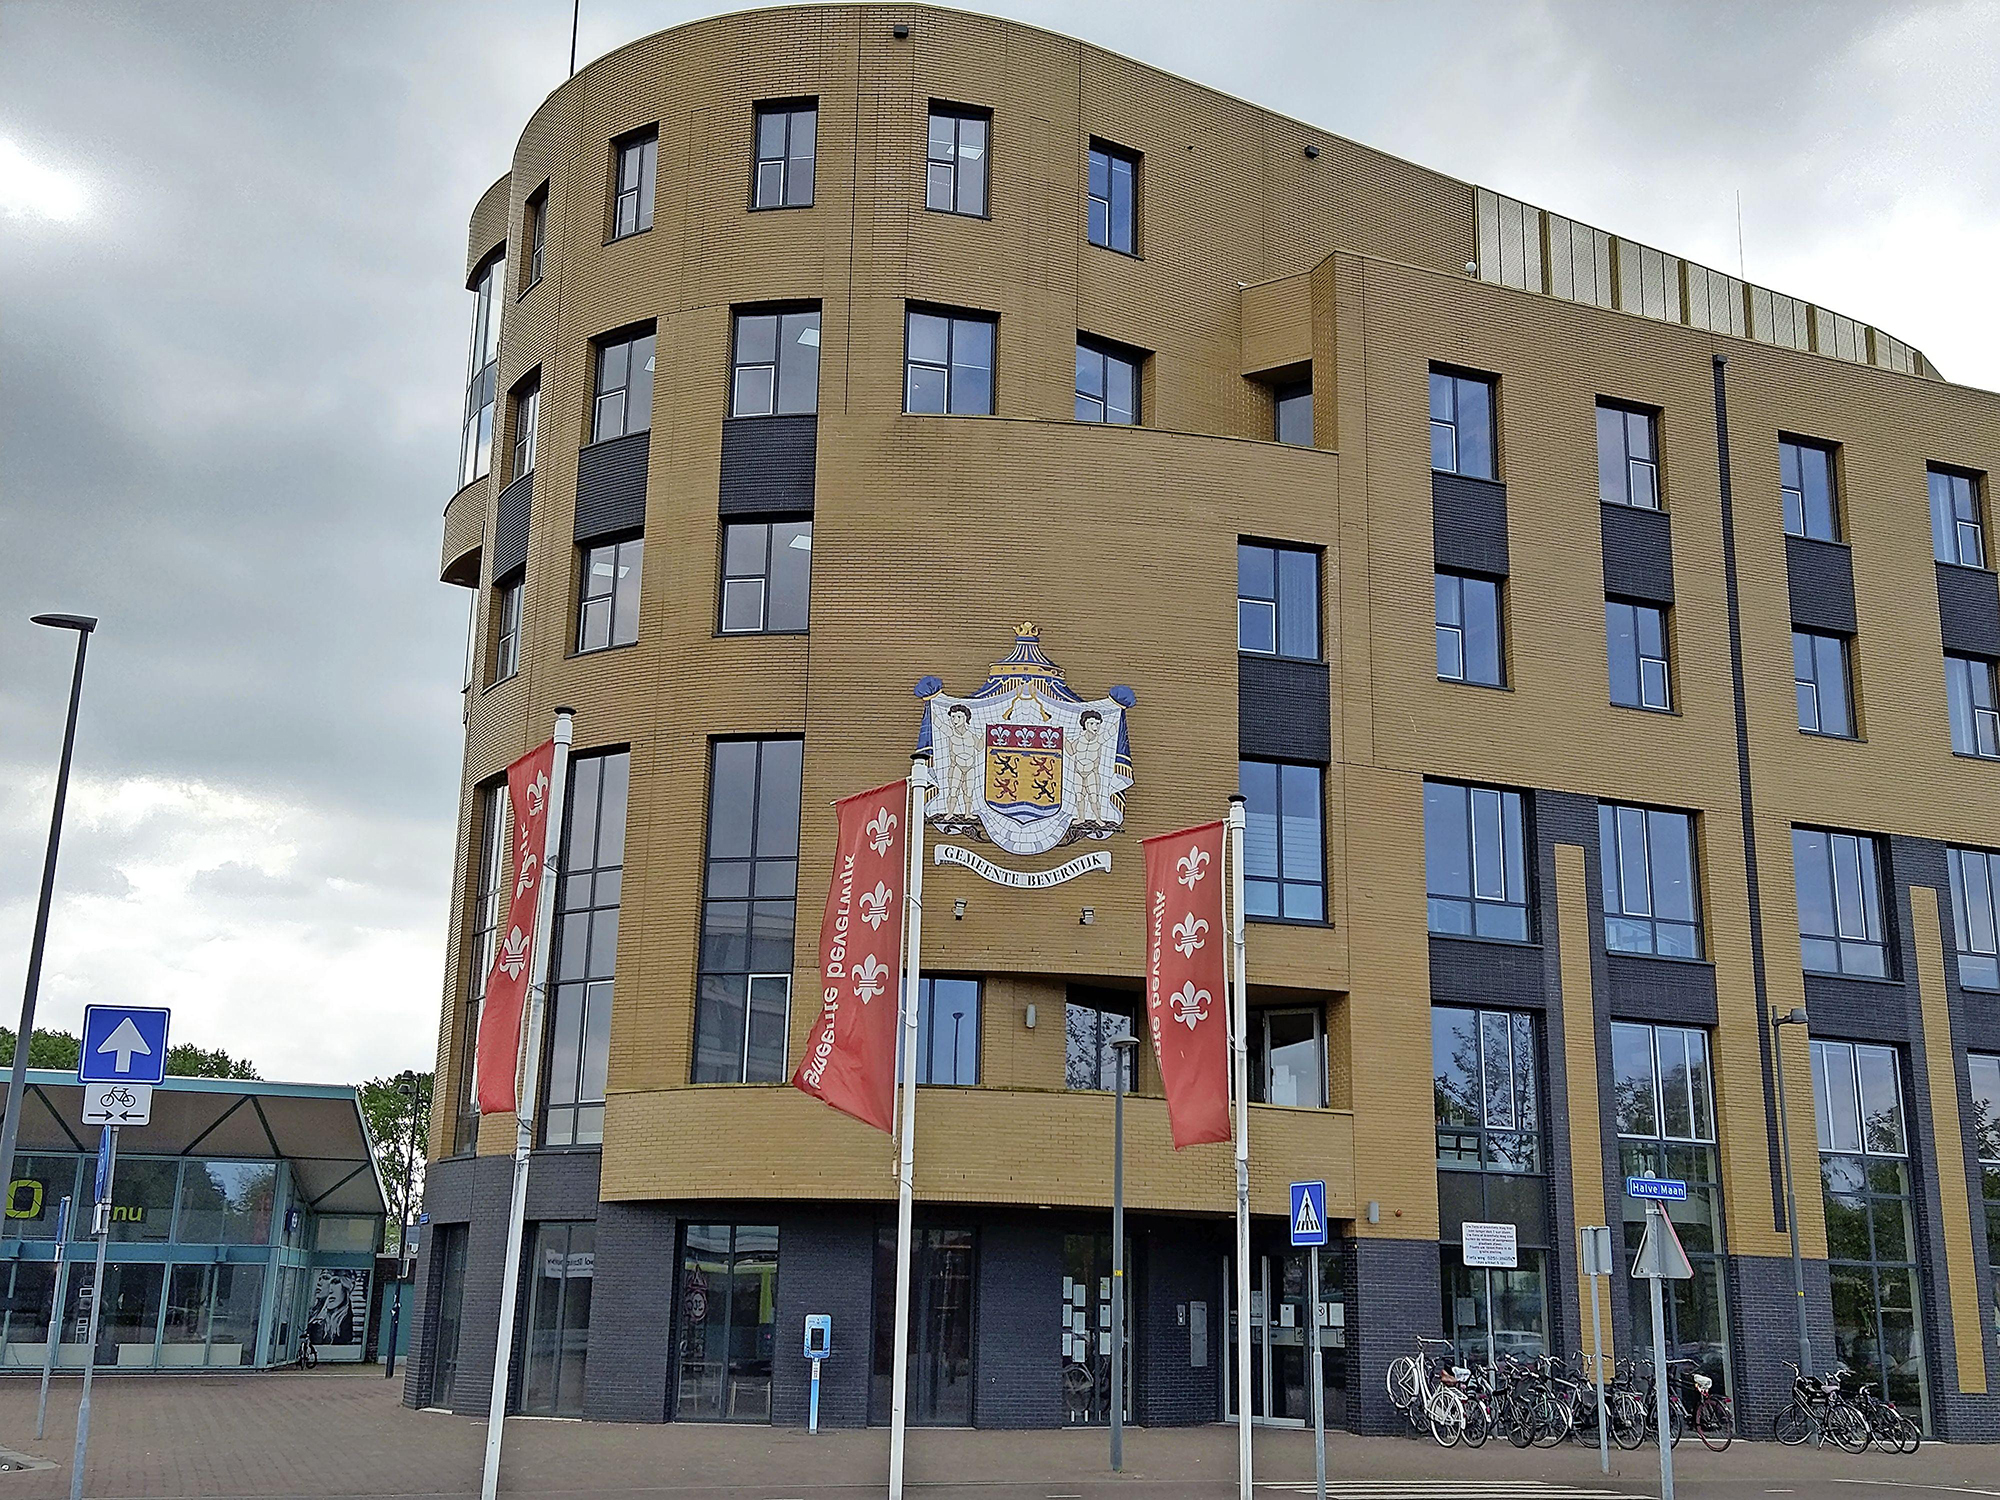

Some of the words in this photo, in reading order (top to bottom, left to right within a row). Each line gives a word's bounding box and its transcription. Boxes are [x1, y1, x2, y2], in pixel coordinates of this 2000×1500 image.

[944, 846, 1019, 885] GEMEENTE
[1027, 854, 1102, 887] BEVERWIJK
[1632, 1182, 1658, 1194] Halve
[1660, 1184, 1684, 1196] Maan
